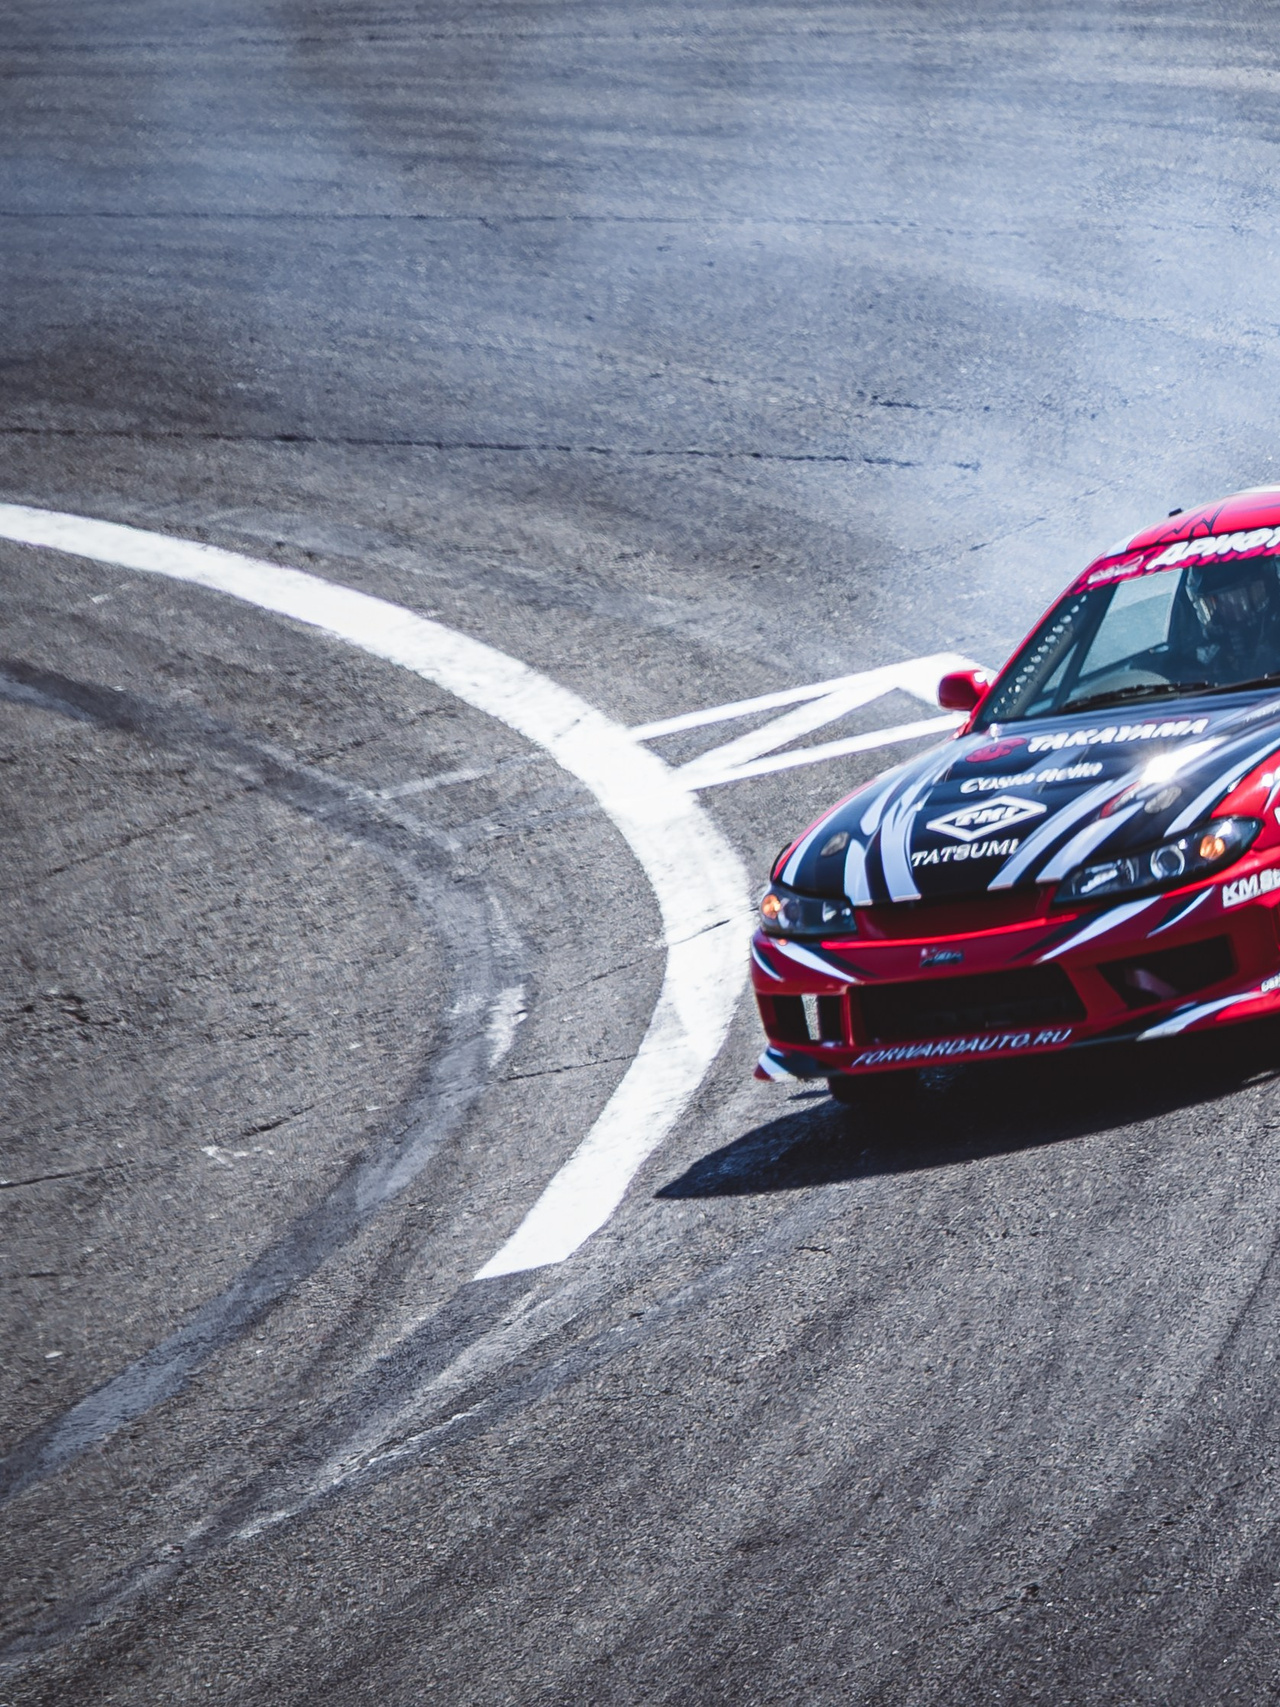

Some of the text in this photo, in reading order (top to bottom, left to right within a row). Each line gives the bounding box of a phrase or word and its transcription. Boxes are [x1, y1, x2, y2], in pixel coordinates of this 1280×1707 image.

[1027, 718, 1209, 753] TAKAYAMA
[911, 838, 1020, 867] TATSUMI
[852, 1028, 1073, 1068] FORWARDAUTO.RU
